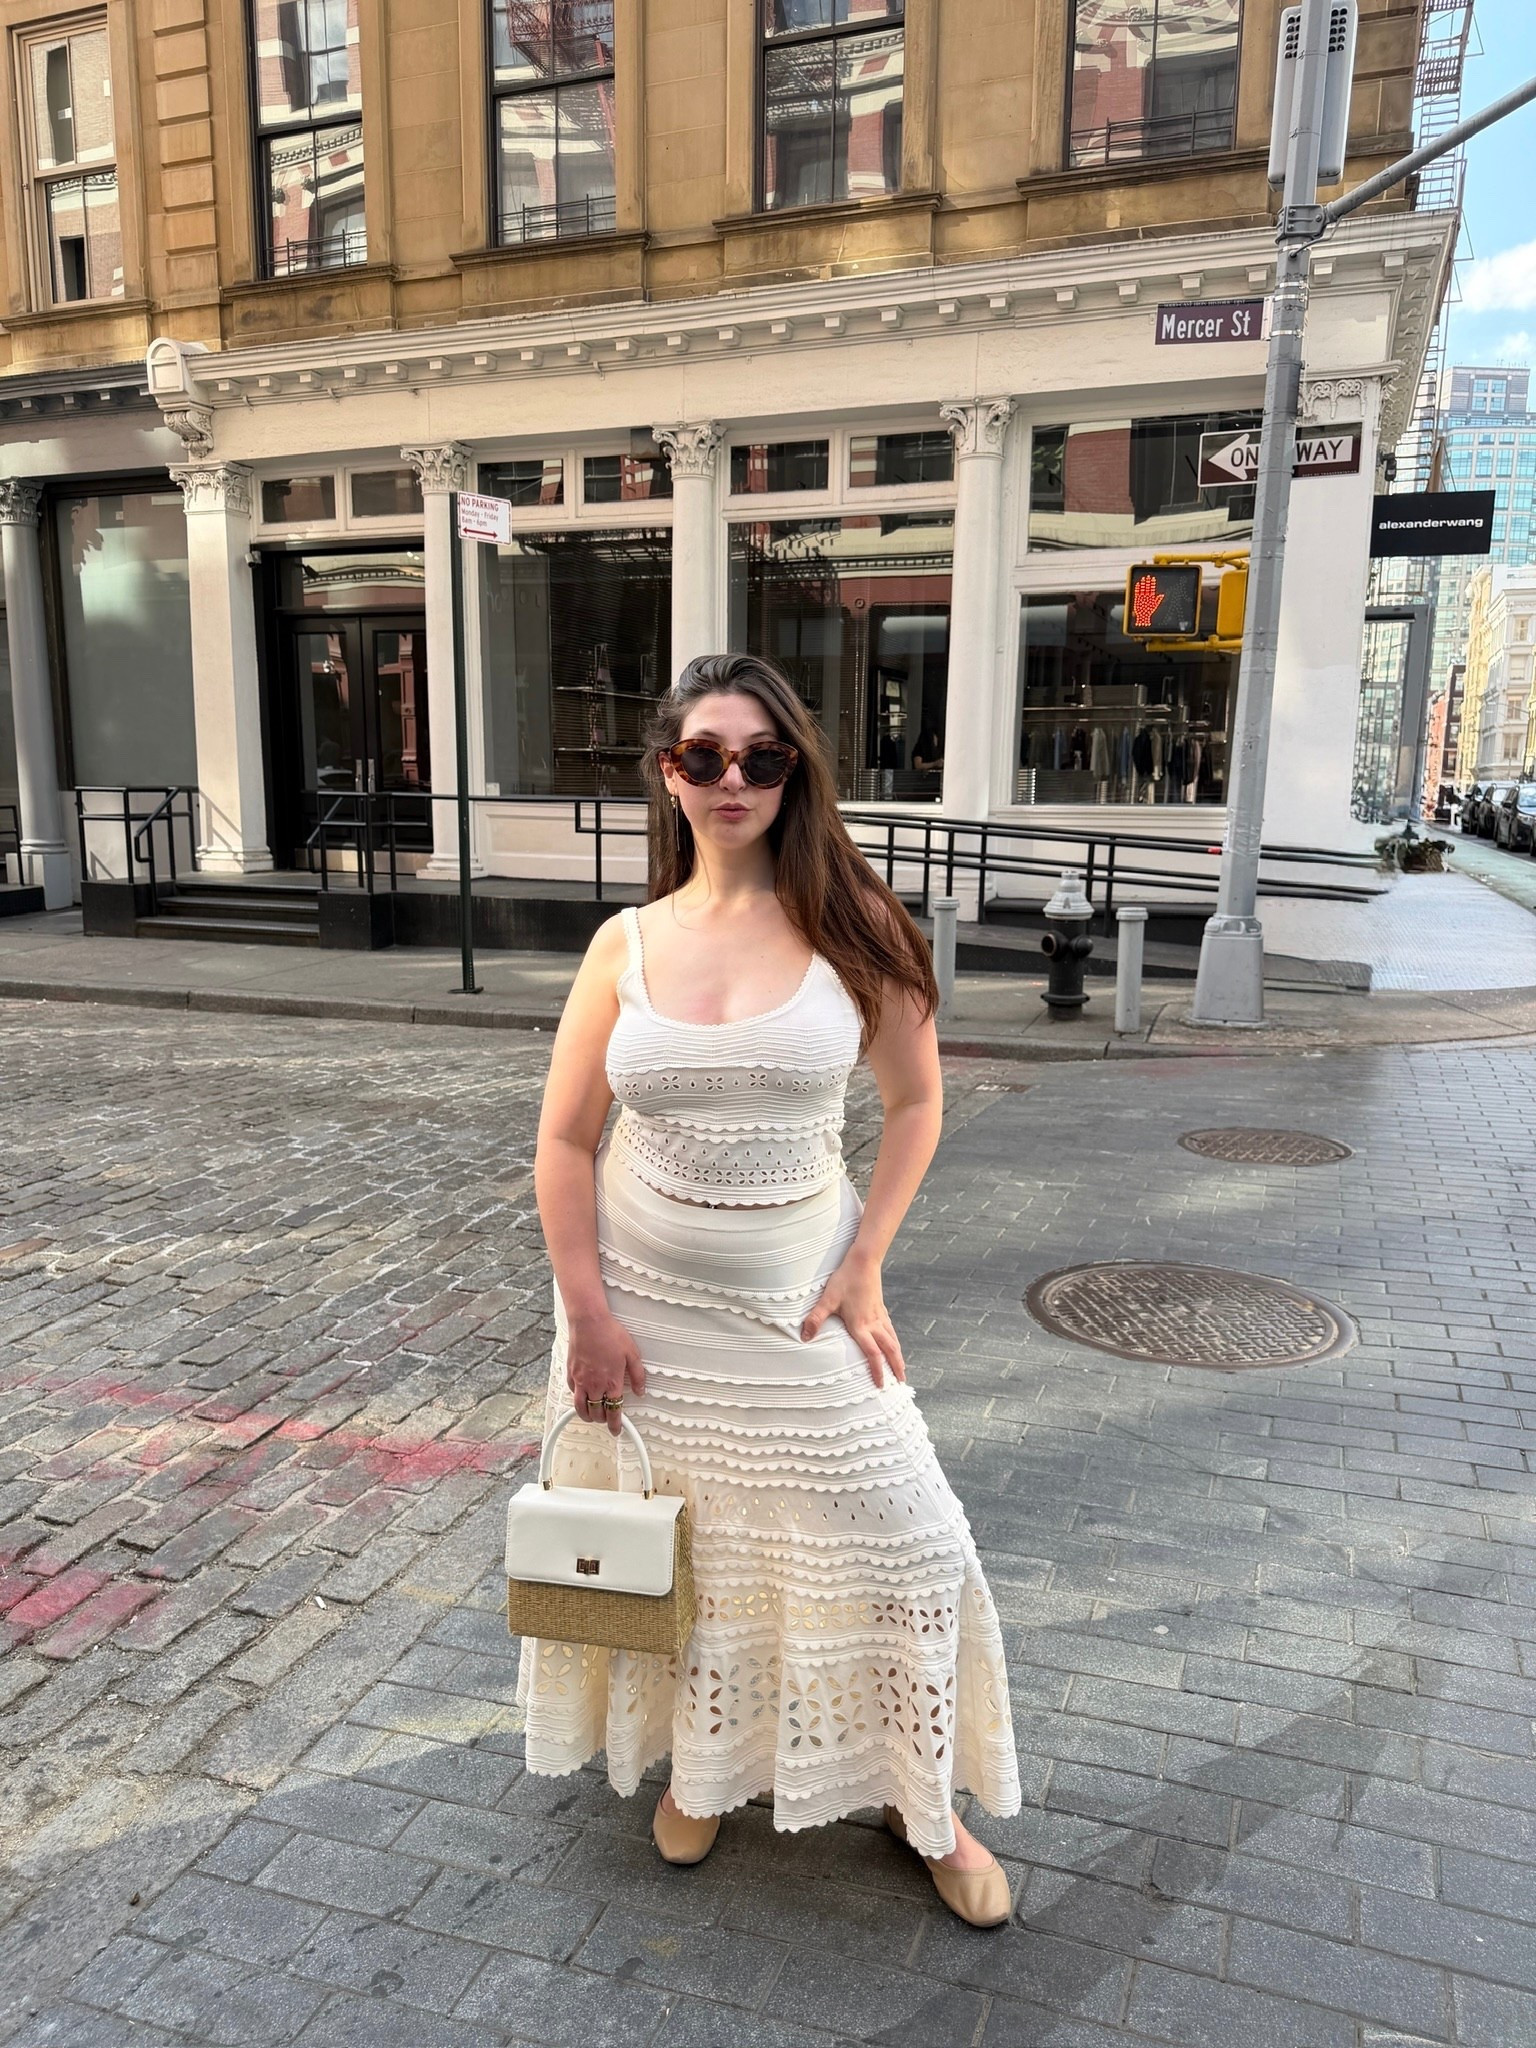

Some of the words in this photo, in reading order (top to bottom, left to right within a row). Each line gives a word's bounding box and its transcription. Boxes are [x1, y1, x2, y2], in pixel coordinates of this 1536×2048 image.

[1161, 313, 1224, 340] Mercer
[1230, 309, 1251, 337] St
[1230, 446, 1260, 468] ON
[1296, 439, 1344, 463] WAY
[461, 497, 470, 506] NO
[472, 499, 499, 512] PARKING
[461, 508, 479, 518] Monday
[484, 511, 499, 521] Friday
[1378, 518, 1484, 530] alexanderwang
